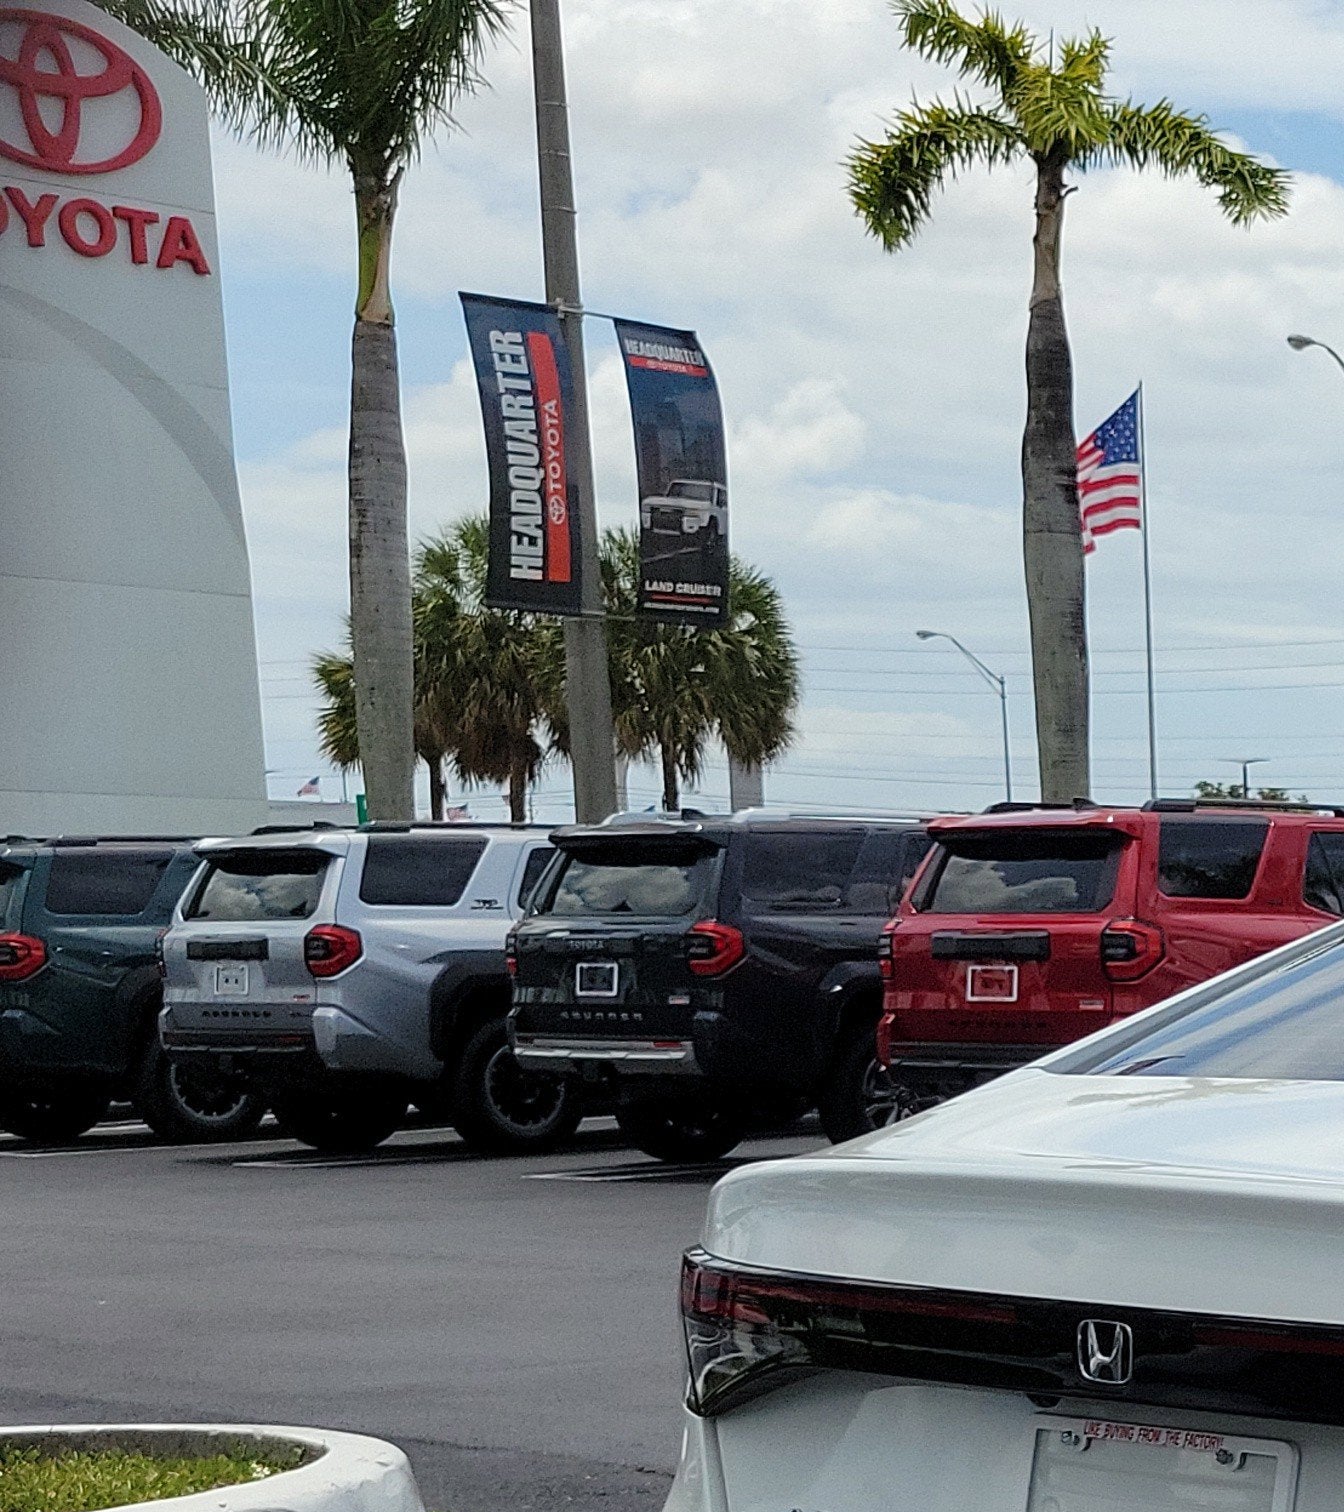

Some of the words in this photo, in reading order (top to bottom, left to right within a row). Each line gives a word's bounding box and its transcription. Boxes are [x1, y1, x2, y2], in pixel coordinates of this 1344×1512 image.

[0, 186, 211, 275] YOTA
[489, 329, 544, 581] HEADQUARTER
[542, 399, 562, 492] TOYOTA
[644, 579, 674, 593] LAND
[1138, 1426, 1163, 1443] FROM
[1164, 1430, 1182, 1446] THE
